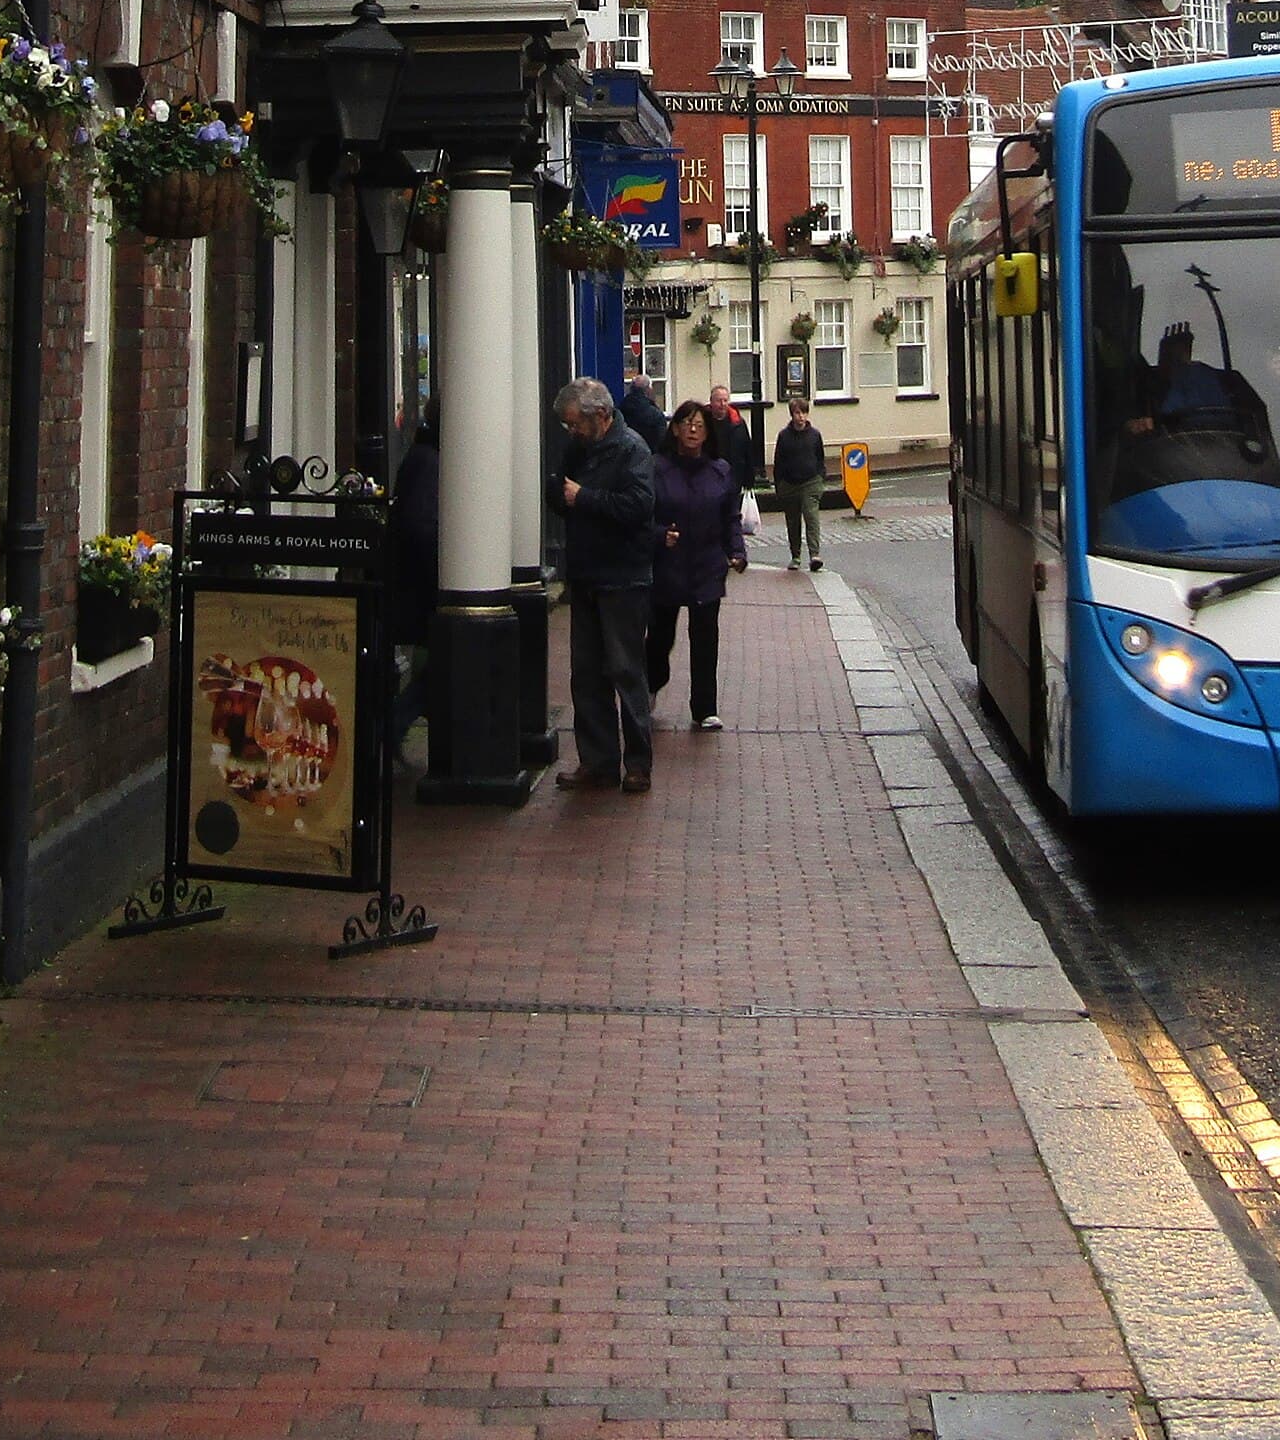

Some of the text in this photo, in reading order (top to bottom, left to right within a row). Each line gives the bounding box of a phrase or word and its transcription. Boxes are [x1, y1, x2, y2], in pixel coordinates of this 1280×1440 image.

[665, 98, 849, 113] EN SUITE ACOMMODATION
[681, 159, 707, 178] HE
[679, 179, 713, 204] UN
[620, 223, 670, 240] ORAL
[199, 534, 370, 550] KINGS ARMS & ROYAL HOTEL
